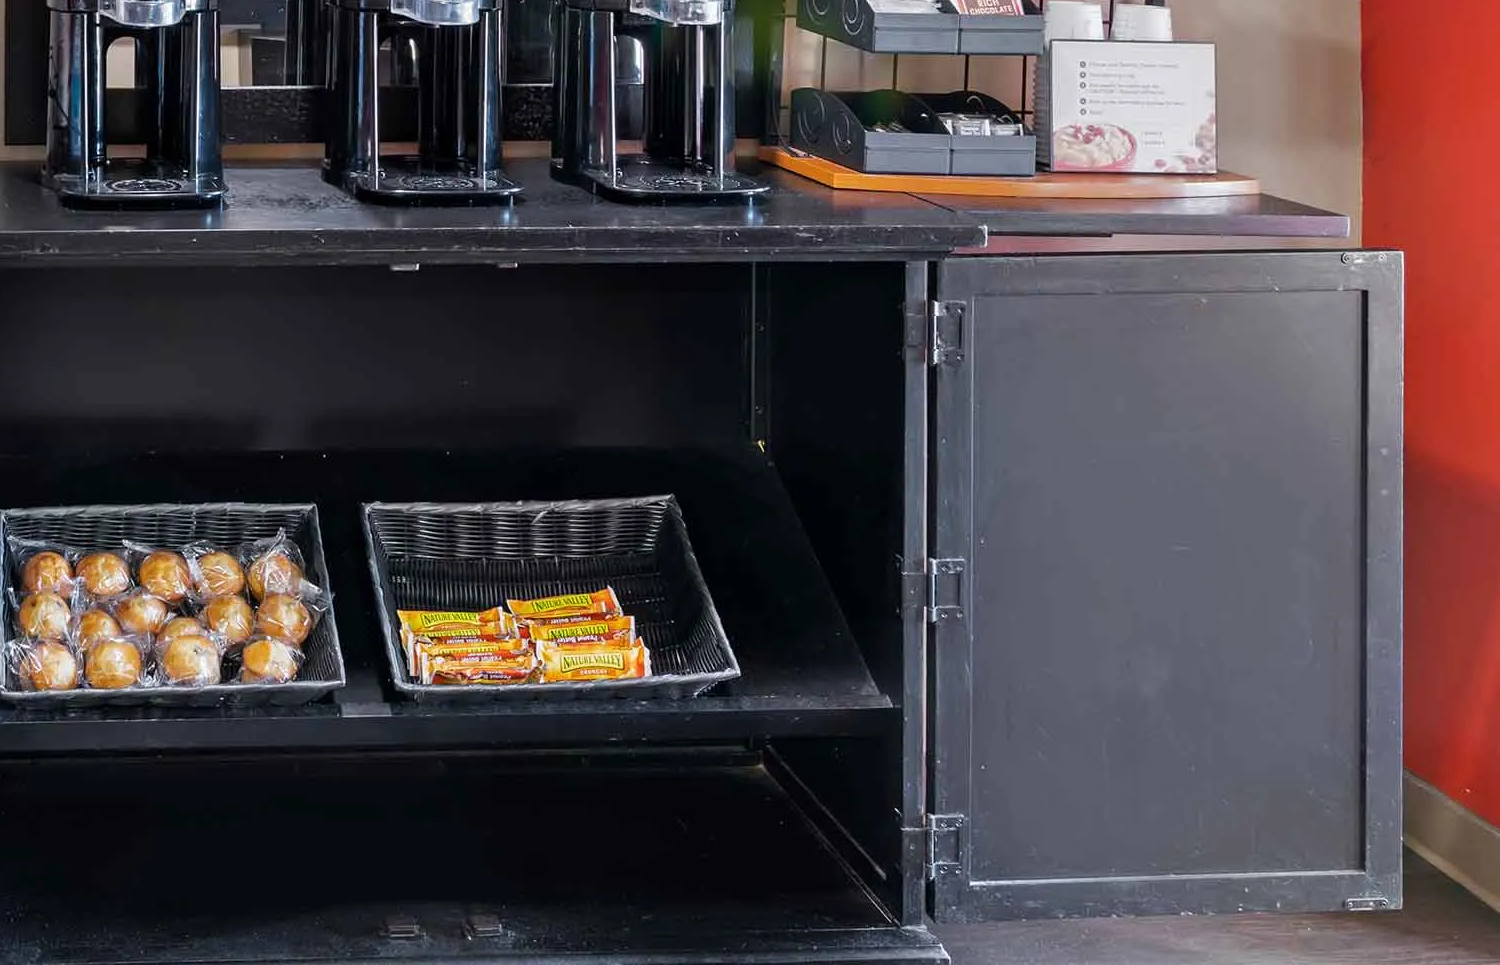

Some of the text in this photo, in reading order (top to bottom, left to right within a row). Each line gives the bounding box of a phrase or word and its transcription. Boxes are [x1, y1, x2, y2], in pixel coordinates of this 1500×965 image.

[969, 5, 1013, 15] CHOCOLATE
[535, 595, 591, 611] NATURE VALLEY
[423, 612, 478, 625] NATURE VALLEY
[549, 624, 607, 638] NATURE VALLEY
[562, 654, 621, 670] NATURE VALLEY
